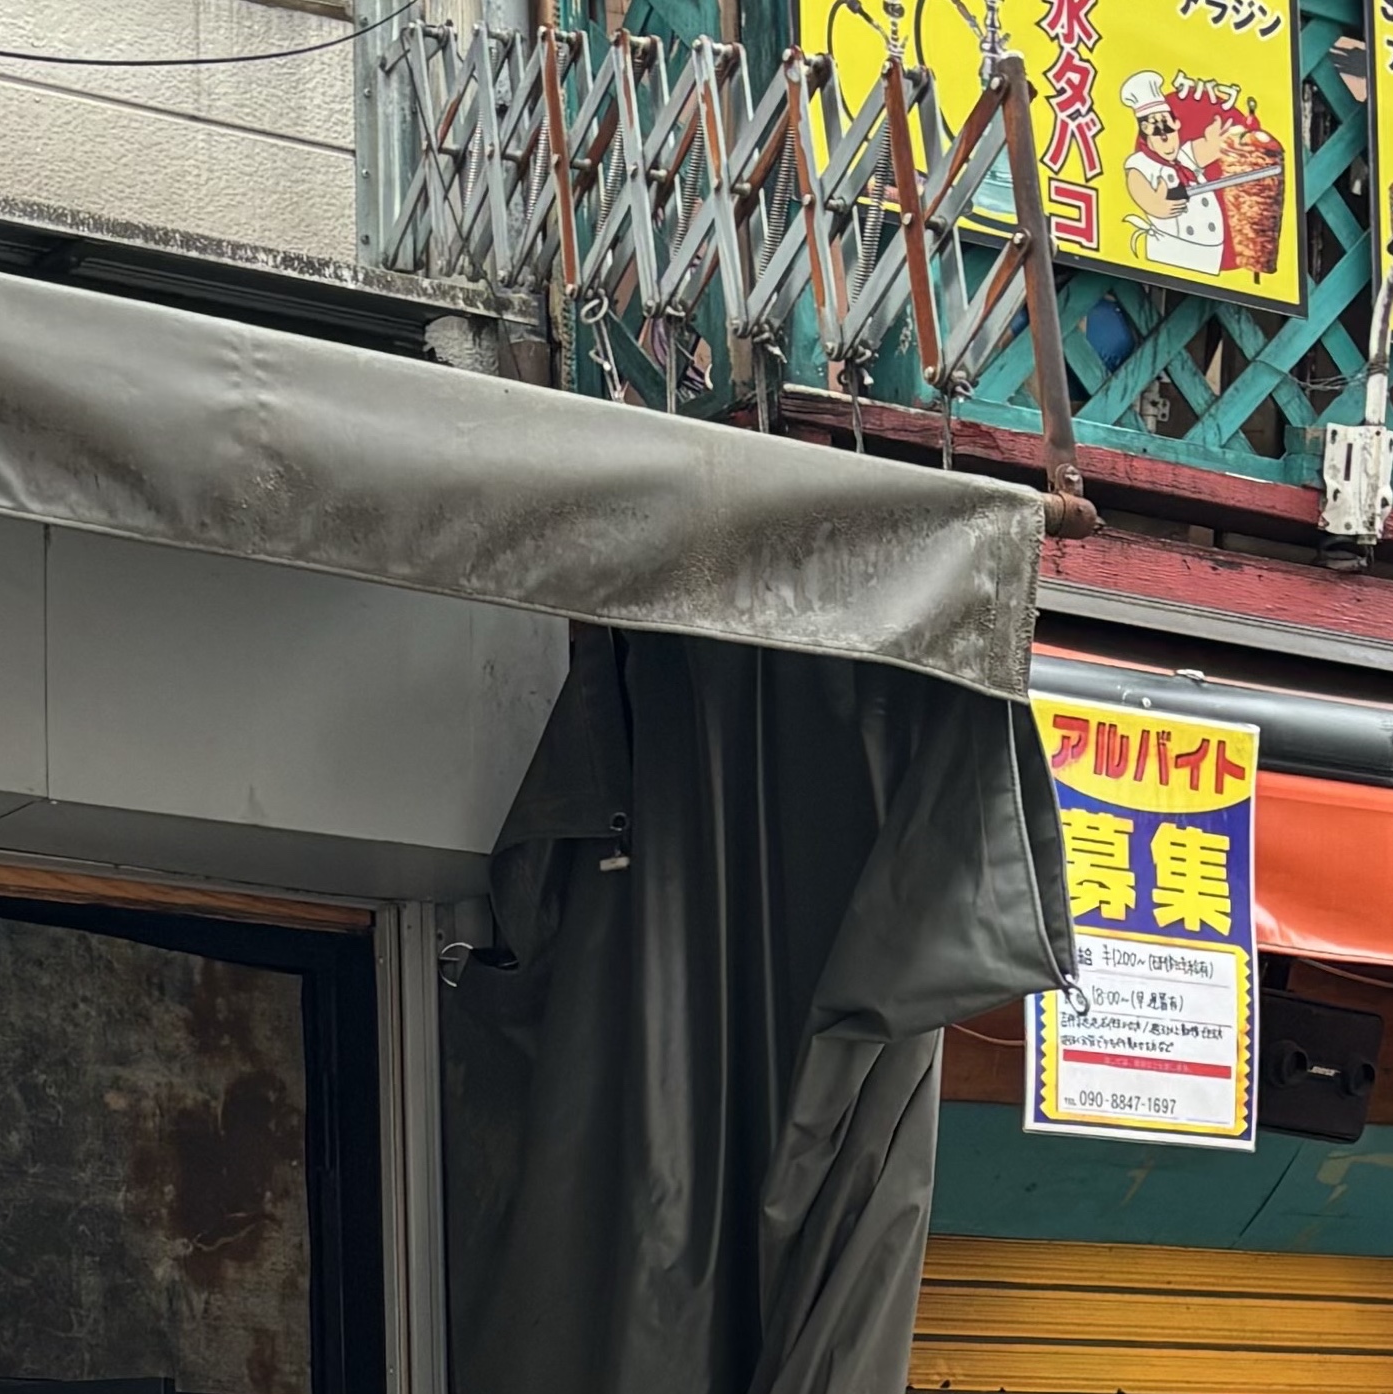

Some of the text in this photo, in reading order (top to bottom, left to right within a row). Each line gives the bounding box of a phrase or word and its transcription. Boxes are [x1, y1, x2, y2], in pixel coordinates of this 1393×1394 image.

[1170, 69, 1242, 110] ケバブ
[1051, 714, 1246, 795] アルバイト
[1062, 808, 1232, 937] 募集
[1079, 1090, 1177, 1115] 090-8847-1697
